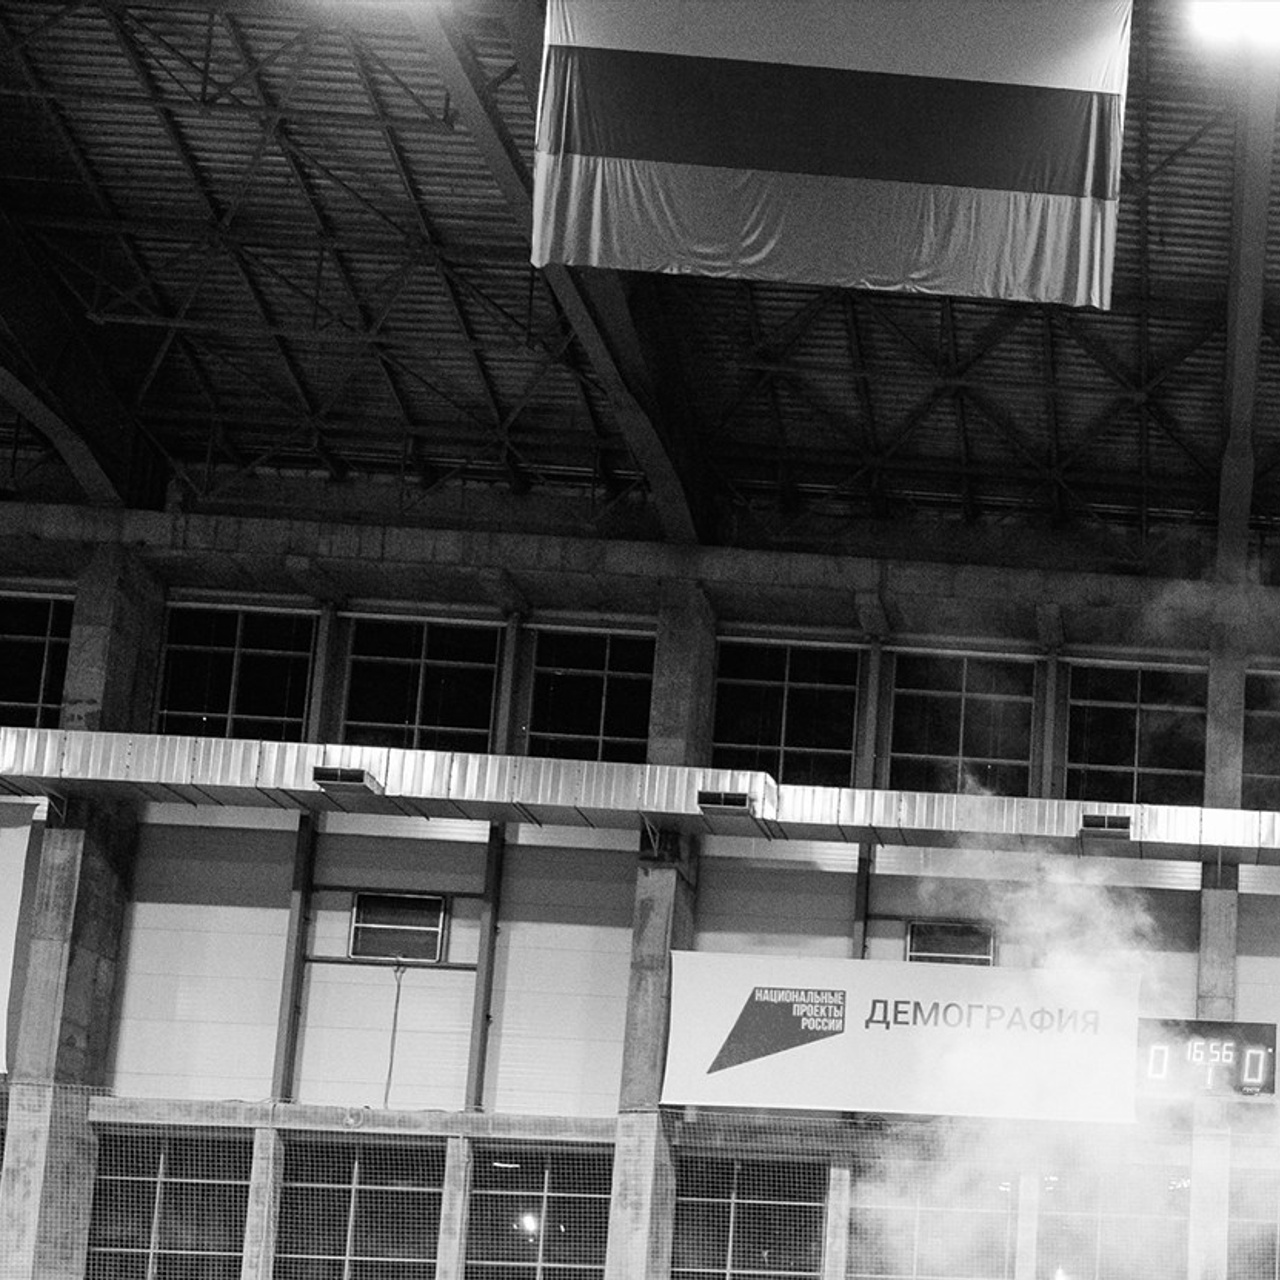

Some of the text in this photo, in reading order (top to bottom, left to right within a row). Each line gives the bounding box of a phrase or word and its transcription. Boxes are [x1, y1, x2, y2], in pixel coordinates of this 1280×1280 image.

[754, 988, 845, 1006] НАЦИОНАЛЬНЫЕ
[792, 1003, 845, 1019] ПРОЕКТЫ
[865, 998, 1101, 1035] ДЕМОГРАФИЯ
[801, 1017, 845, 1033] РОССИИ
